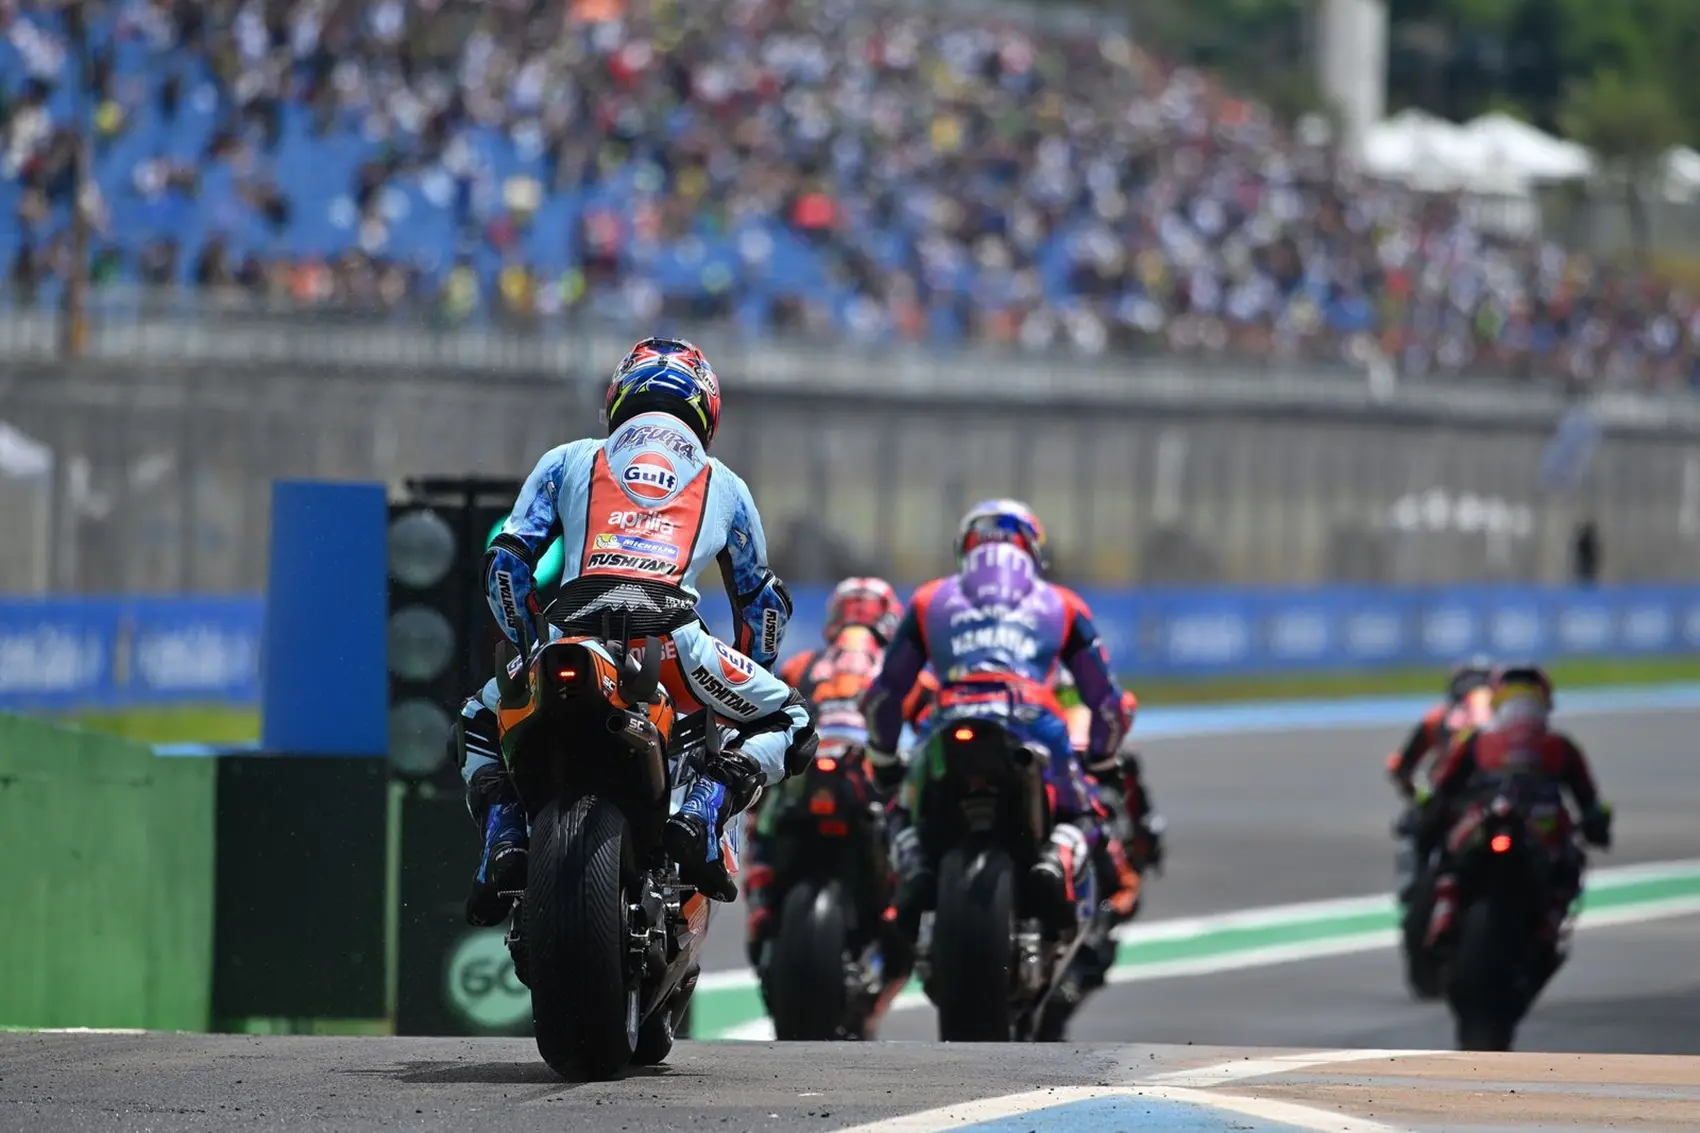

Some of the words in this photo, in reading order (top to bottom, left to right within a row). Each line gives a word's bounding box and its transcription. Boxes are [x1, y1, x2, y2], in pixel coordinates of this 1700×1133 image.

[611, 425, 699, 465] OGURA
[624, 466, 676, 489] Gulf
[608, 510, 673, 535] aprilia
[622, 539, 676, 554] MICHELIN
[714, 641, 754, 675] Gulf
[629, 718, 644, 731] SC
